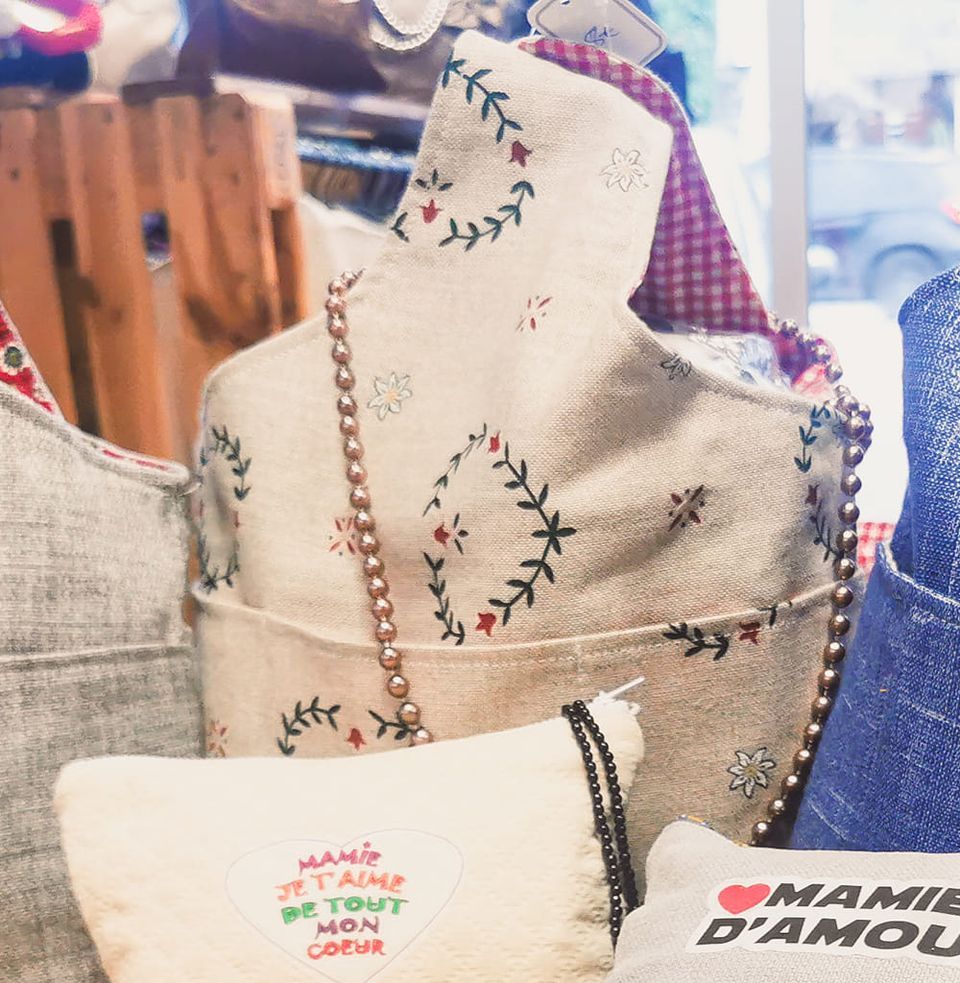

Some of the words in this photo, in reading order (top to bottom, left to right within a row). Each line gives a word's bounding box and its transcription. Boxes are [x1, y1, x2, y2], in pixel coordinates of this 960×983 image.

[274, 879, 308, 902] JE
[281, 902, 318, 925] DE
[324, 896, 409, 915] TOUT
[315, 916, 380, 939] MON
[307, 939, 386, 960] COEUR
